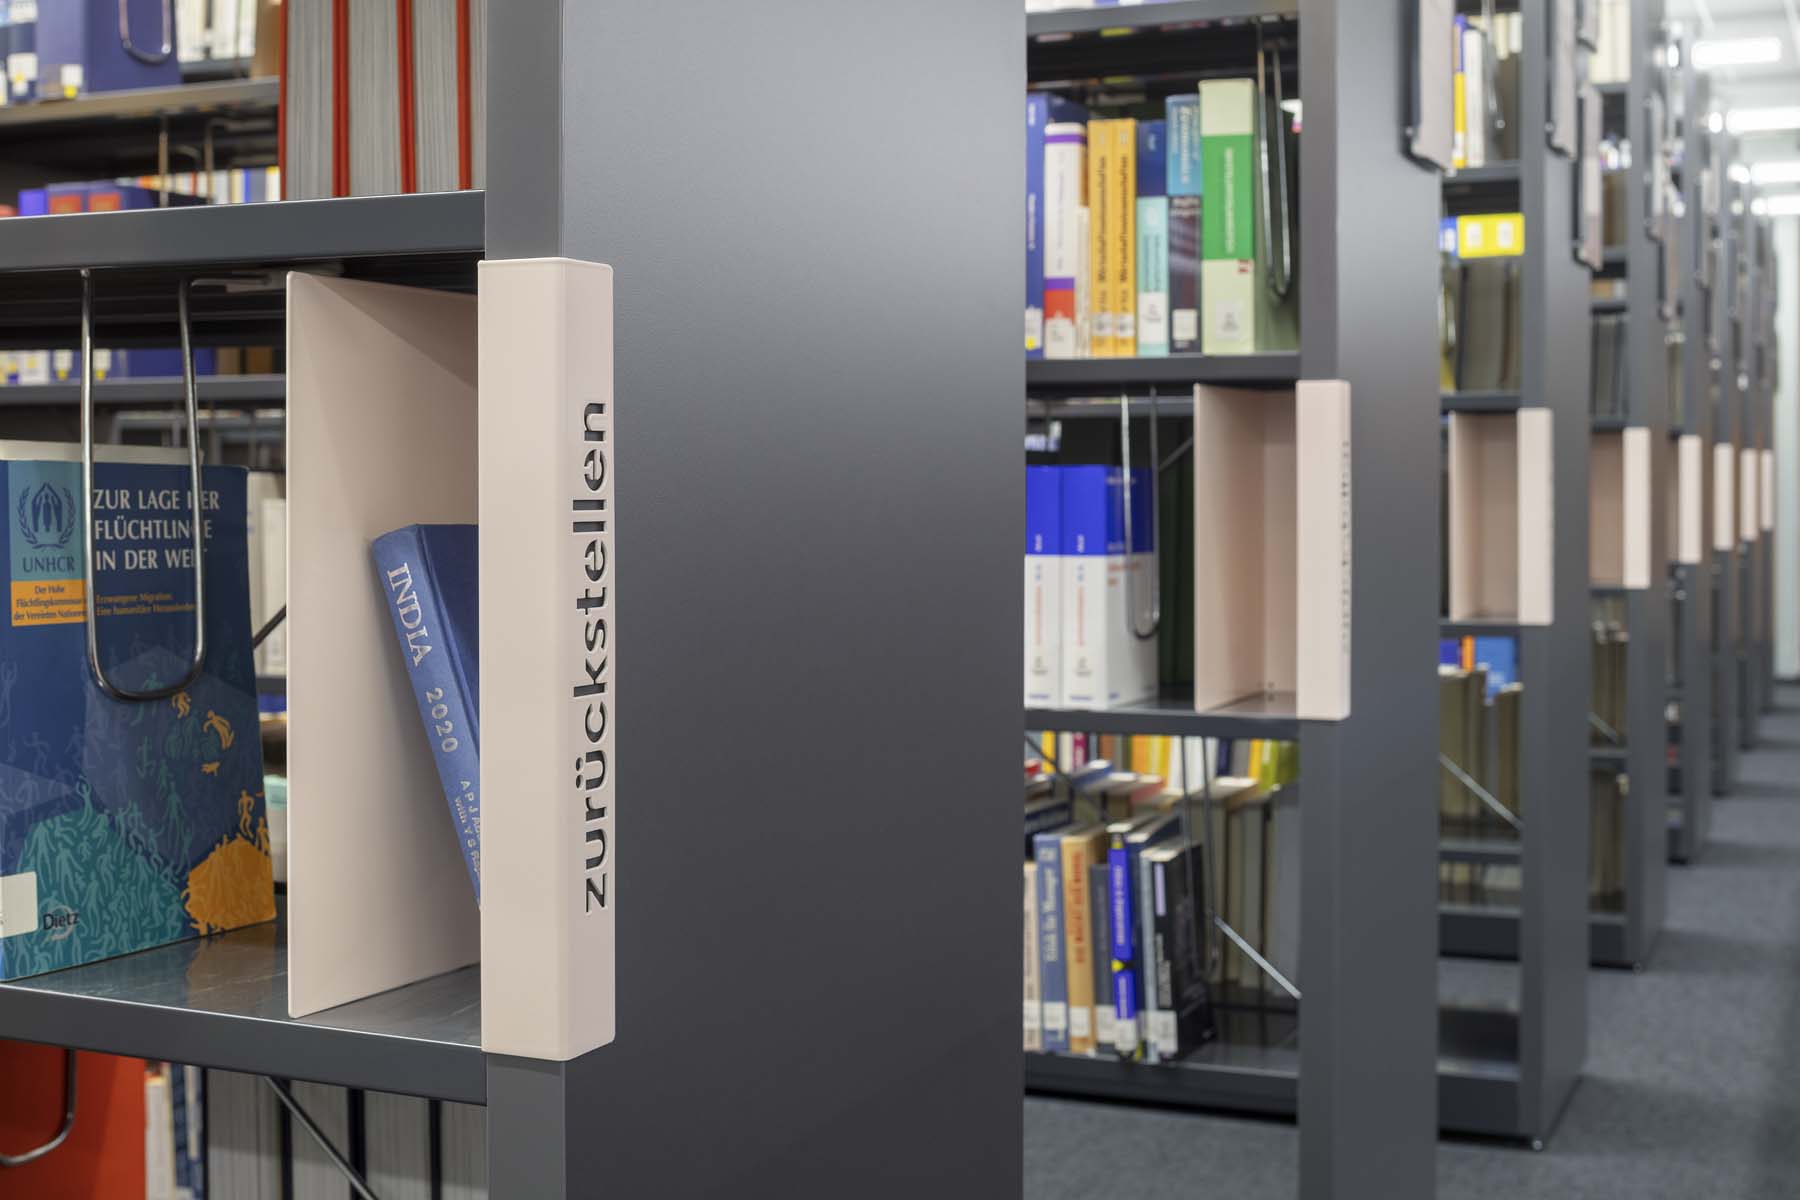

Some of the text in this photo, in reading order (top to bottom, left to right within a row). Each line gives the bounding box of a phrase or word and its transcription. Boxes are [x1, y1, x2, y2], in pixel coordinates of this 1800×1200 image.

[93, 489, 131, 510] ZUR
[138, 490, 181, 510] LAGE
[95, 515, 213, 540] FLÜCHTLINE
[23, 556, 76, 573] UNHCR
[96, 550, 116, 571] IN
[124, 550, 158, 570] DER
[387, 562, 459, 754] INDIA 2020
[573, 401, 609, 913] zurückstellen
[460, 780, 471, 792] A
[464, 791, 475, 802] P
[468, 805, 479, 814] J
[43, 911, 80, 931] Dietz
